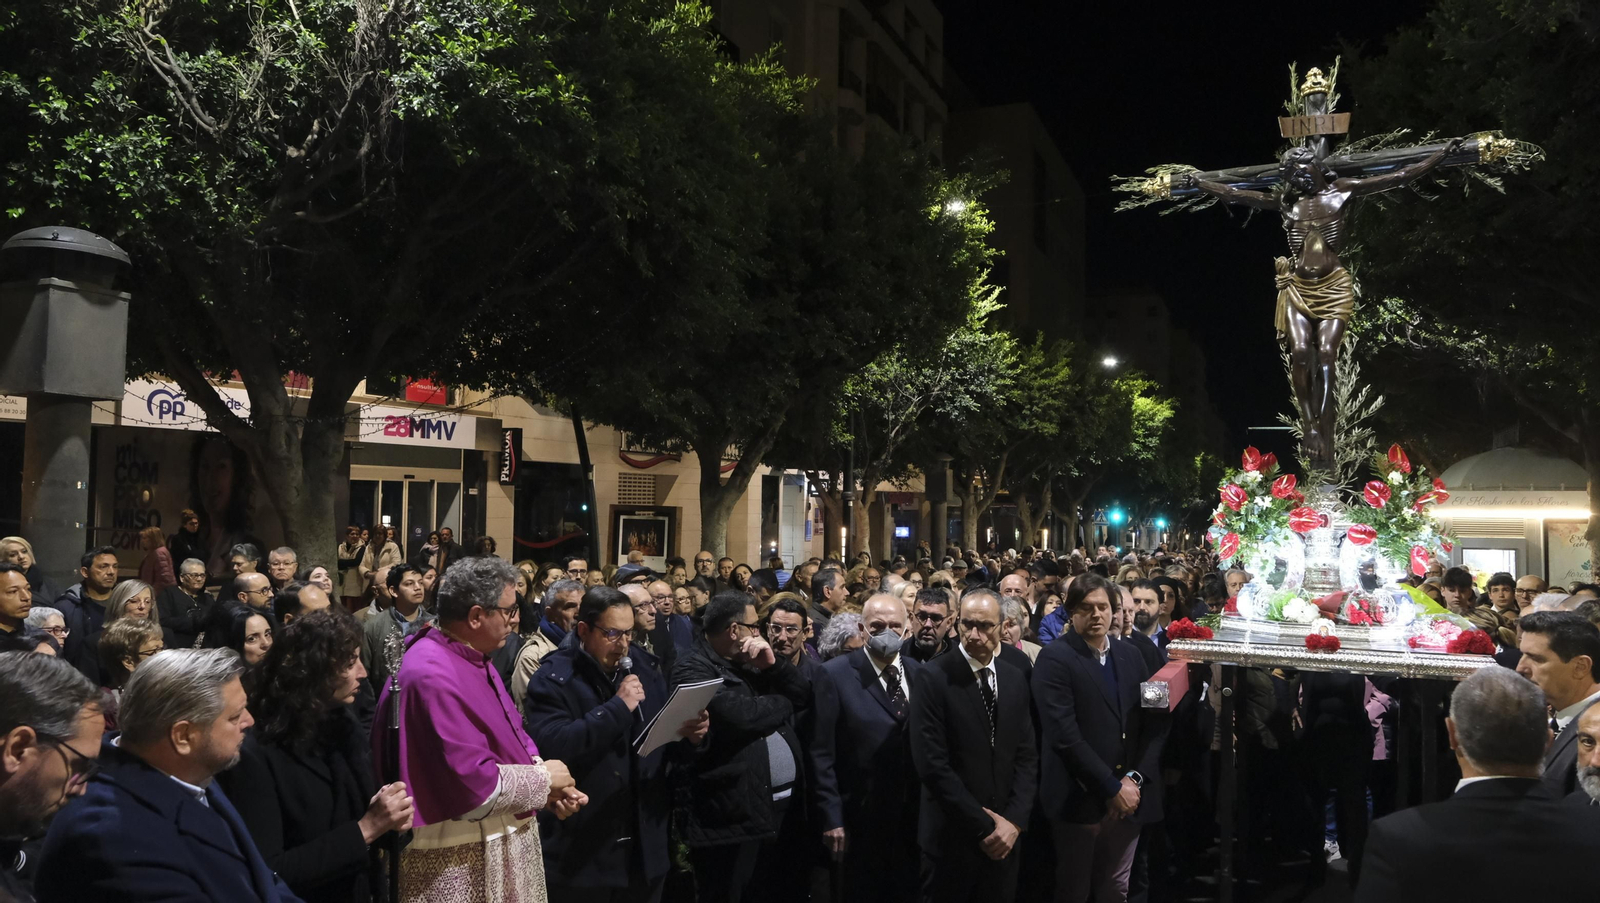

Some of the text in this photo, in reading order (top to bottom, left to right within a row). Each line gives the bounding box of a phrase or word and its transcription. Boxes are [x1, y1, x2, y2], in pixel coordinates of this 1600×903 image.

[1291, 116, 1335, 135] INRI
[114, 461, 158, 485] COM
[113, 484, 154, 509] PRO
[1451, 496, 1464, 506] El
[1506, 497, 1517, 506] de
[1520, 497, 1534, 506] las
[1537, 496, 1569, 506] Flores
[112, 508, 161, 530] MISO
